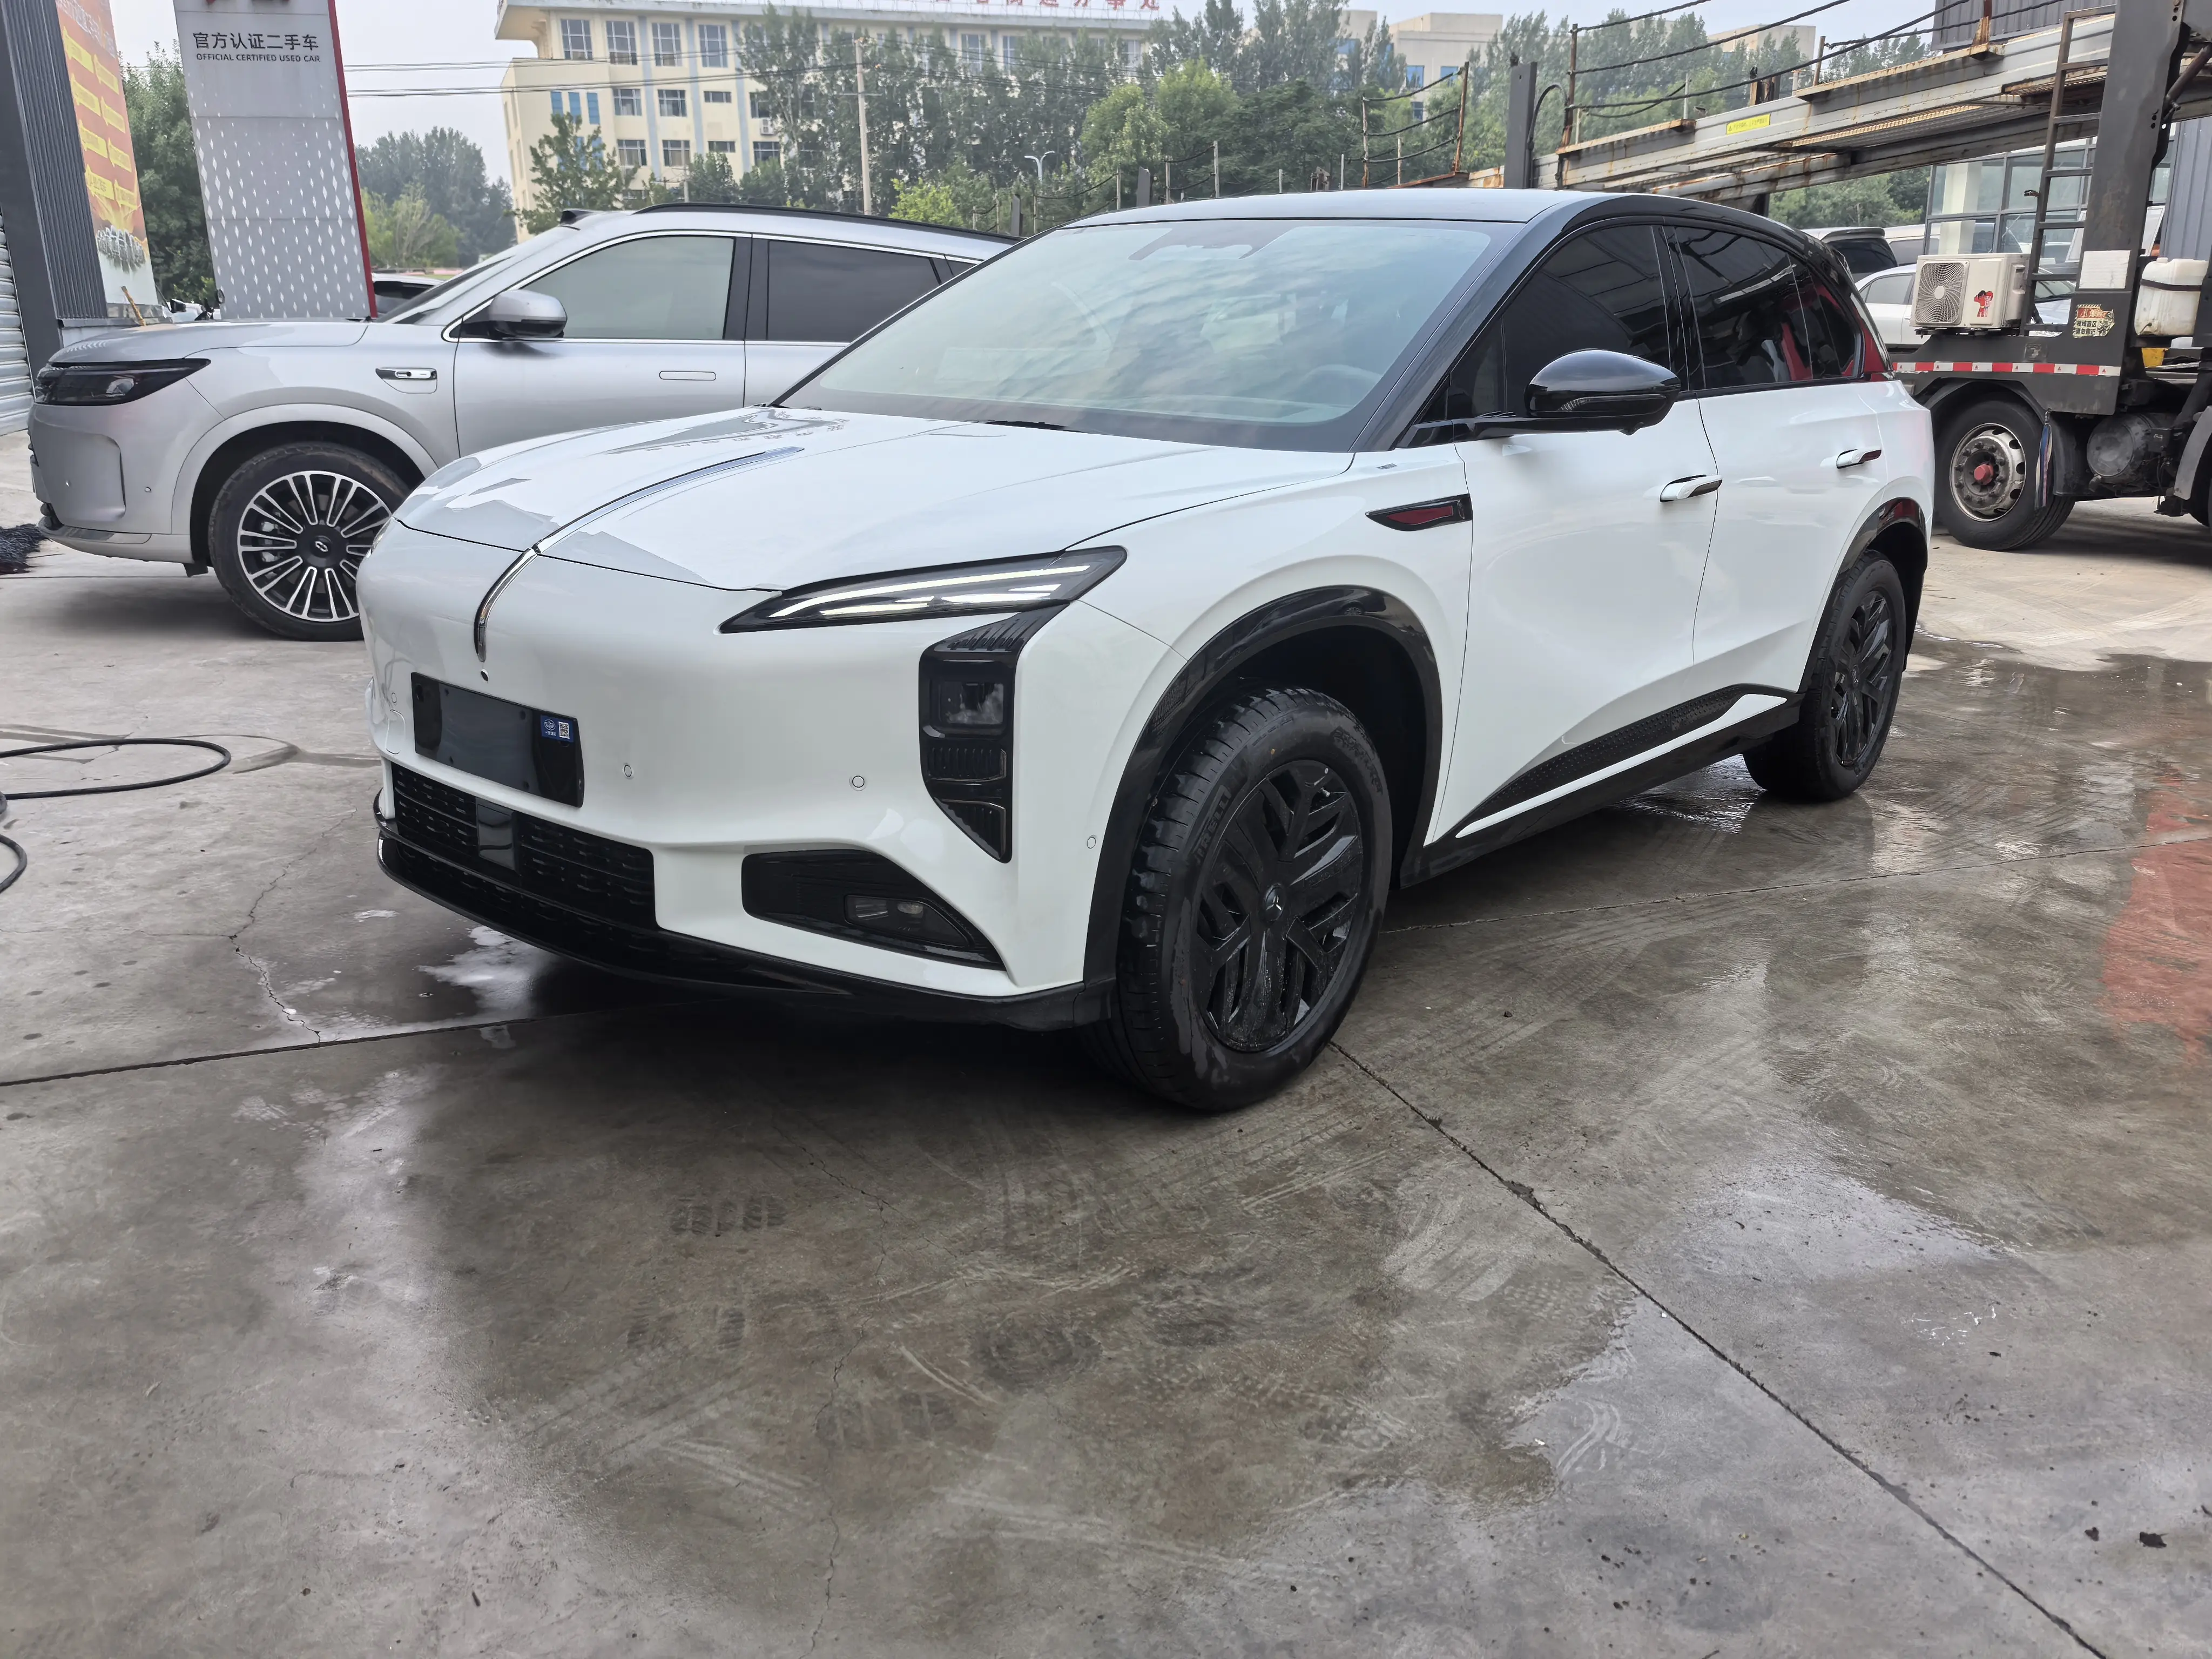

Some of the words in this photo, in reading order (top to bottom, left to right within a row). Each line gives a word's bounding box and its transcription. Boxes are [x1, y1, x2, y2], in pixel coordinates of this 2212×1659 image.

[193, 32, 319, 50] 官方认证二手车
[196, 53, 234, 61] OFFICIAL
[235, 53, 276, 62] CERTIFIED
